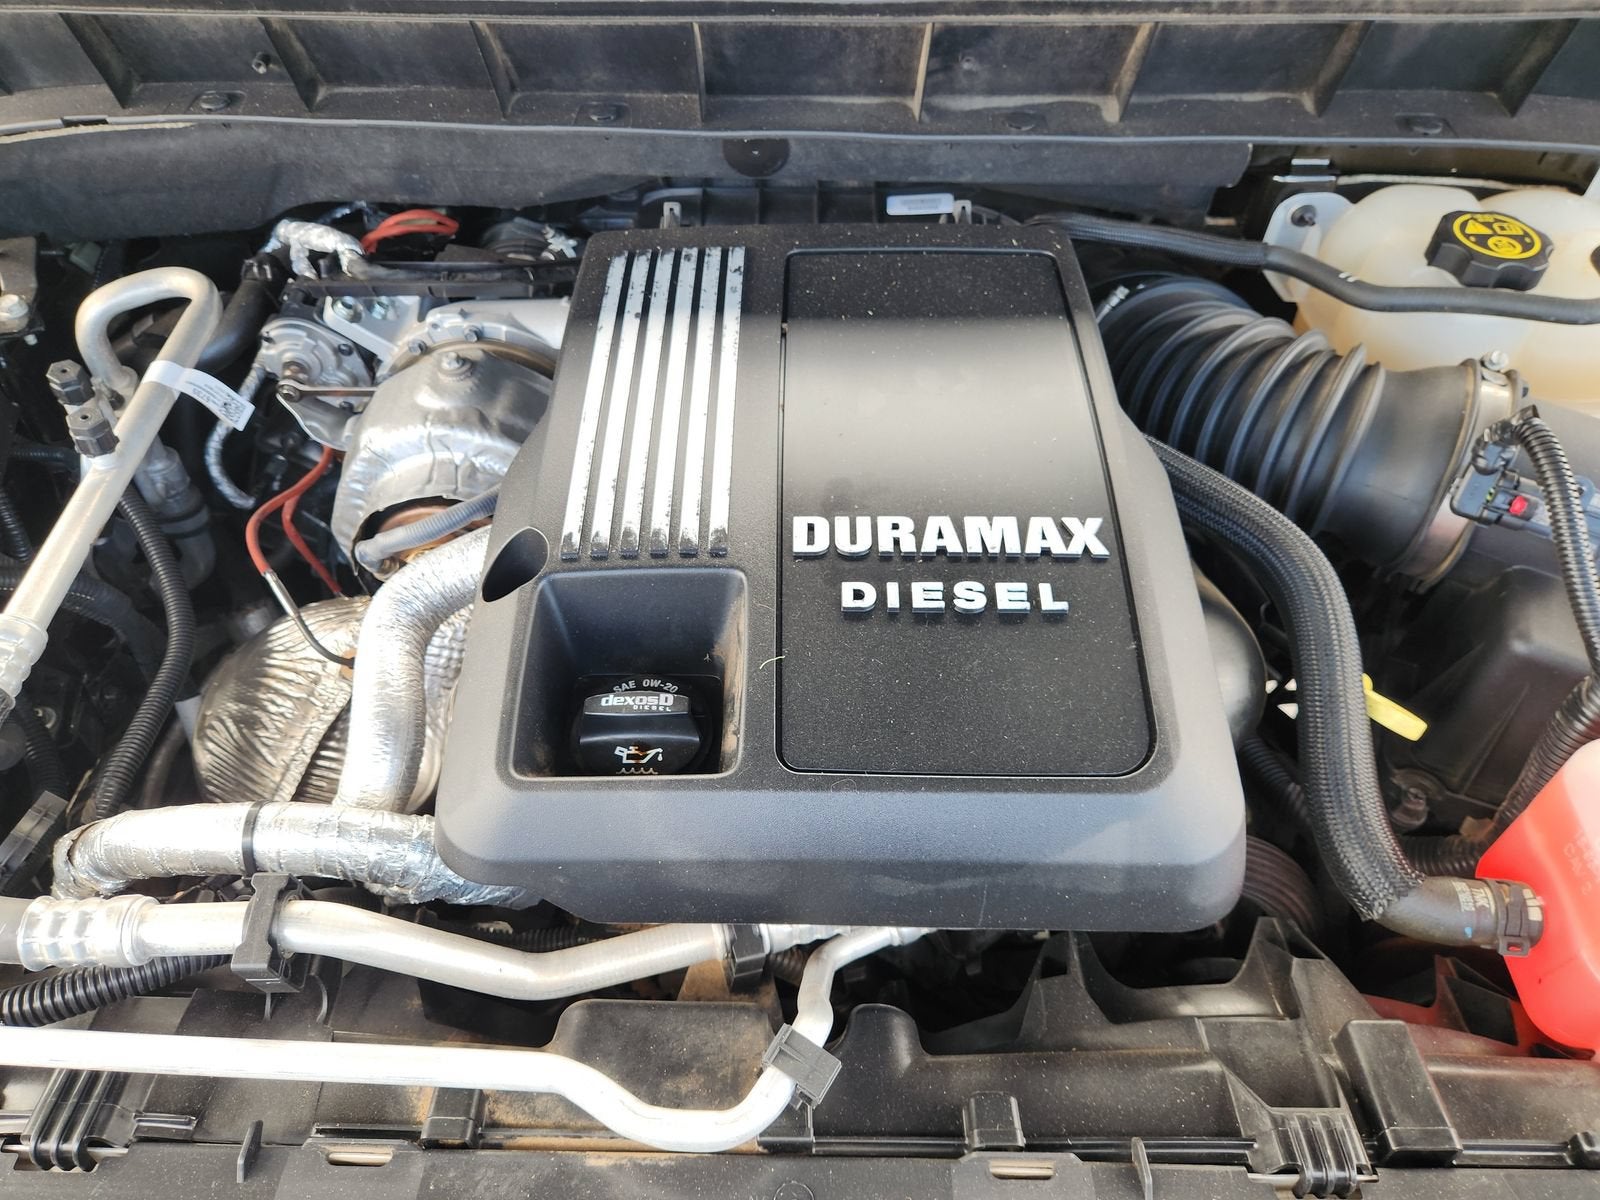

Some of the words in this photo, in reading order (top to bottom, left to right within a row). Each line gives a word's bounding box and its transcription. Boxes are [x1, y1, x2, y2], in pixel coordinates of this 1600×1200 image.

[792, 515, 1111, 559] DURAMAX
[840, 581, 1069, 615] DIESEL
[613, 680, 637, 694] SAE
